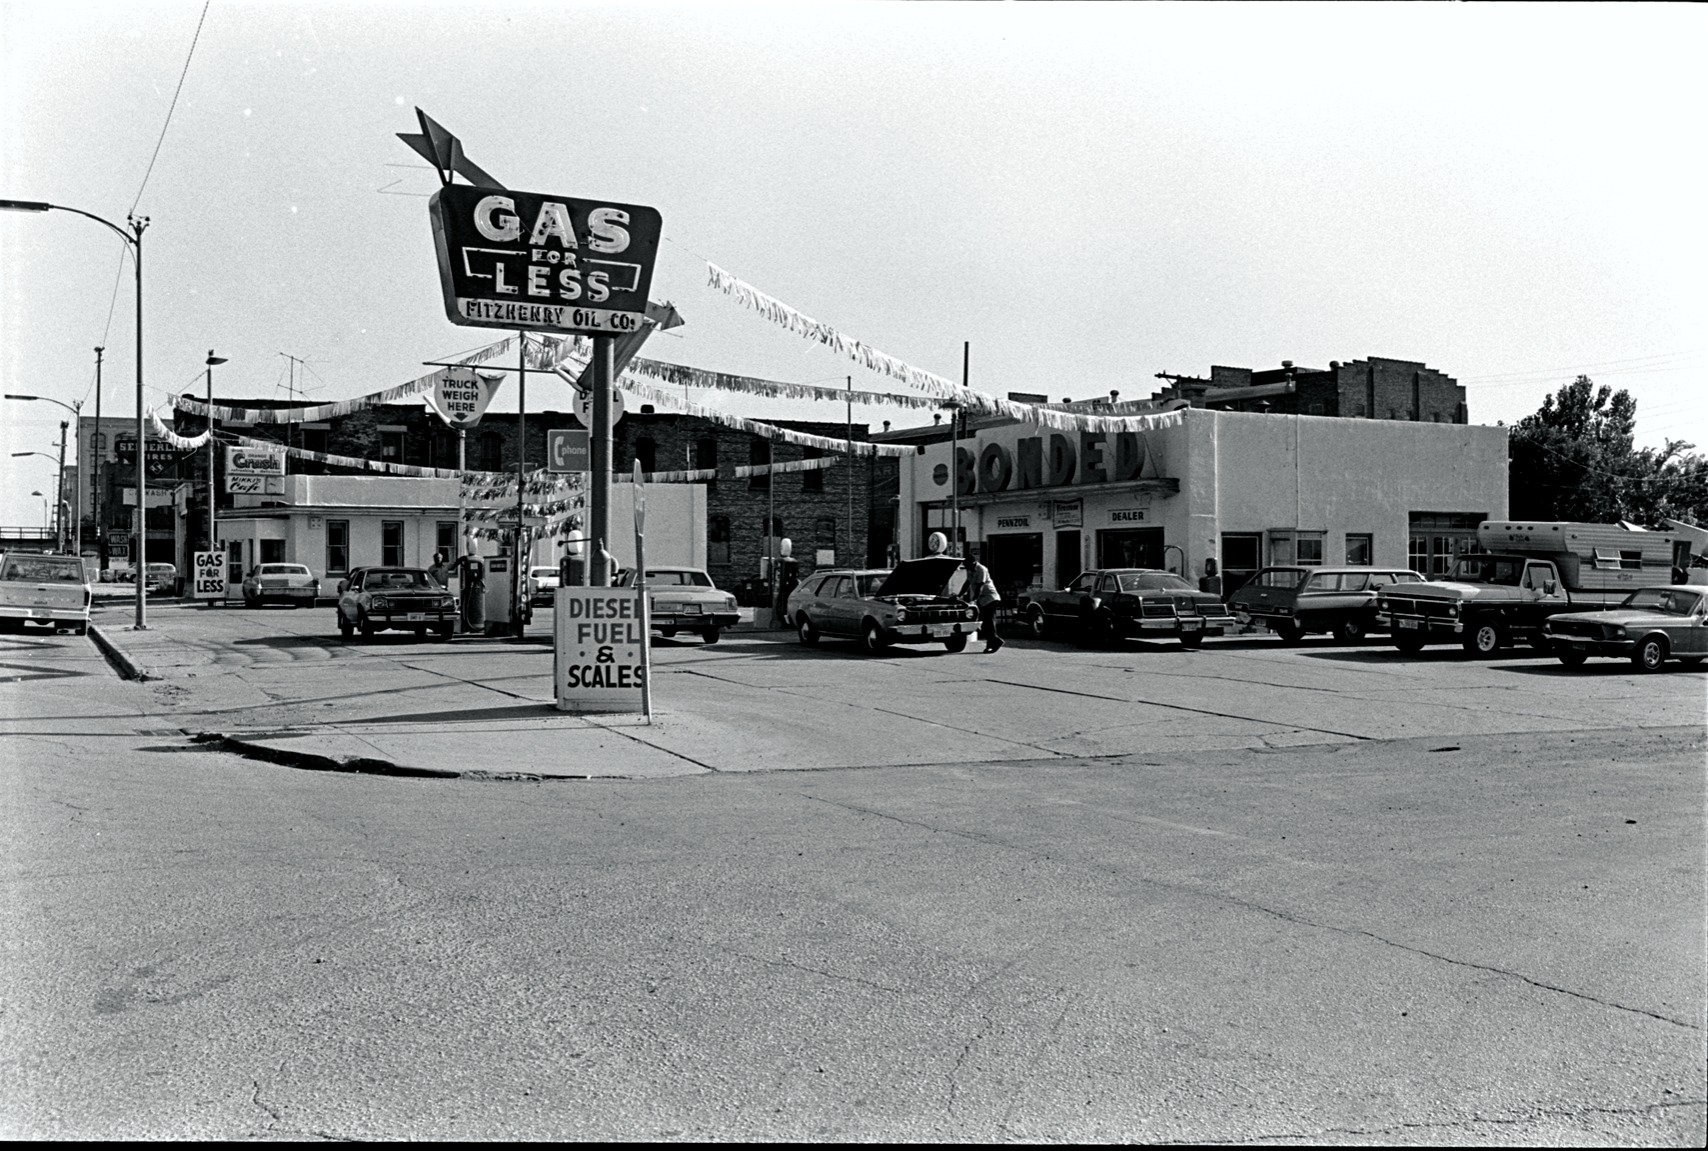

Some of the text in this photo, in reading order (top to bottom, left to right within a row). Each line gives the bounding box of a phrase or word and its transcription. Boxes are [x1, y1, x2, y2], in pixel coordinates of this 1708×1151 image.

[474, 195, 630, 254] GAS
[532, 249, 576, 268] FOR
[496, 262, 609, 302] LESS
[466, 300, 565, 325] FITZHENRY
[573, 309, 601, 328] OIL
[442, 379, 479, 390] TRUCK
[442, 390, 479, 401] WEIGH
[447, 402, 475, 412] HERE
[144, 453, 173, 461] IRES
[562, 445, 587, 456] phone
[233, 453, 281, 470] Crush
[956, 431, 1144, 495] BONDED
[997, 518, 1030, 528] PENNZOIL
[1112, 511, 1144, 522] DEALER
[196, 554, 223, 567] GAS
[200, 569, 220, 578] FOR
[196, 580, 224, 593] LESS
[577, 623, 641, 644] FUEL
[596, 645, 616, 663] &
[567, 664, 643, 688] SCALES
